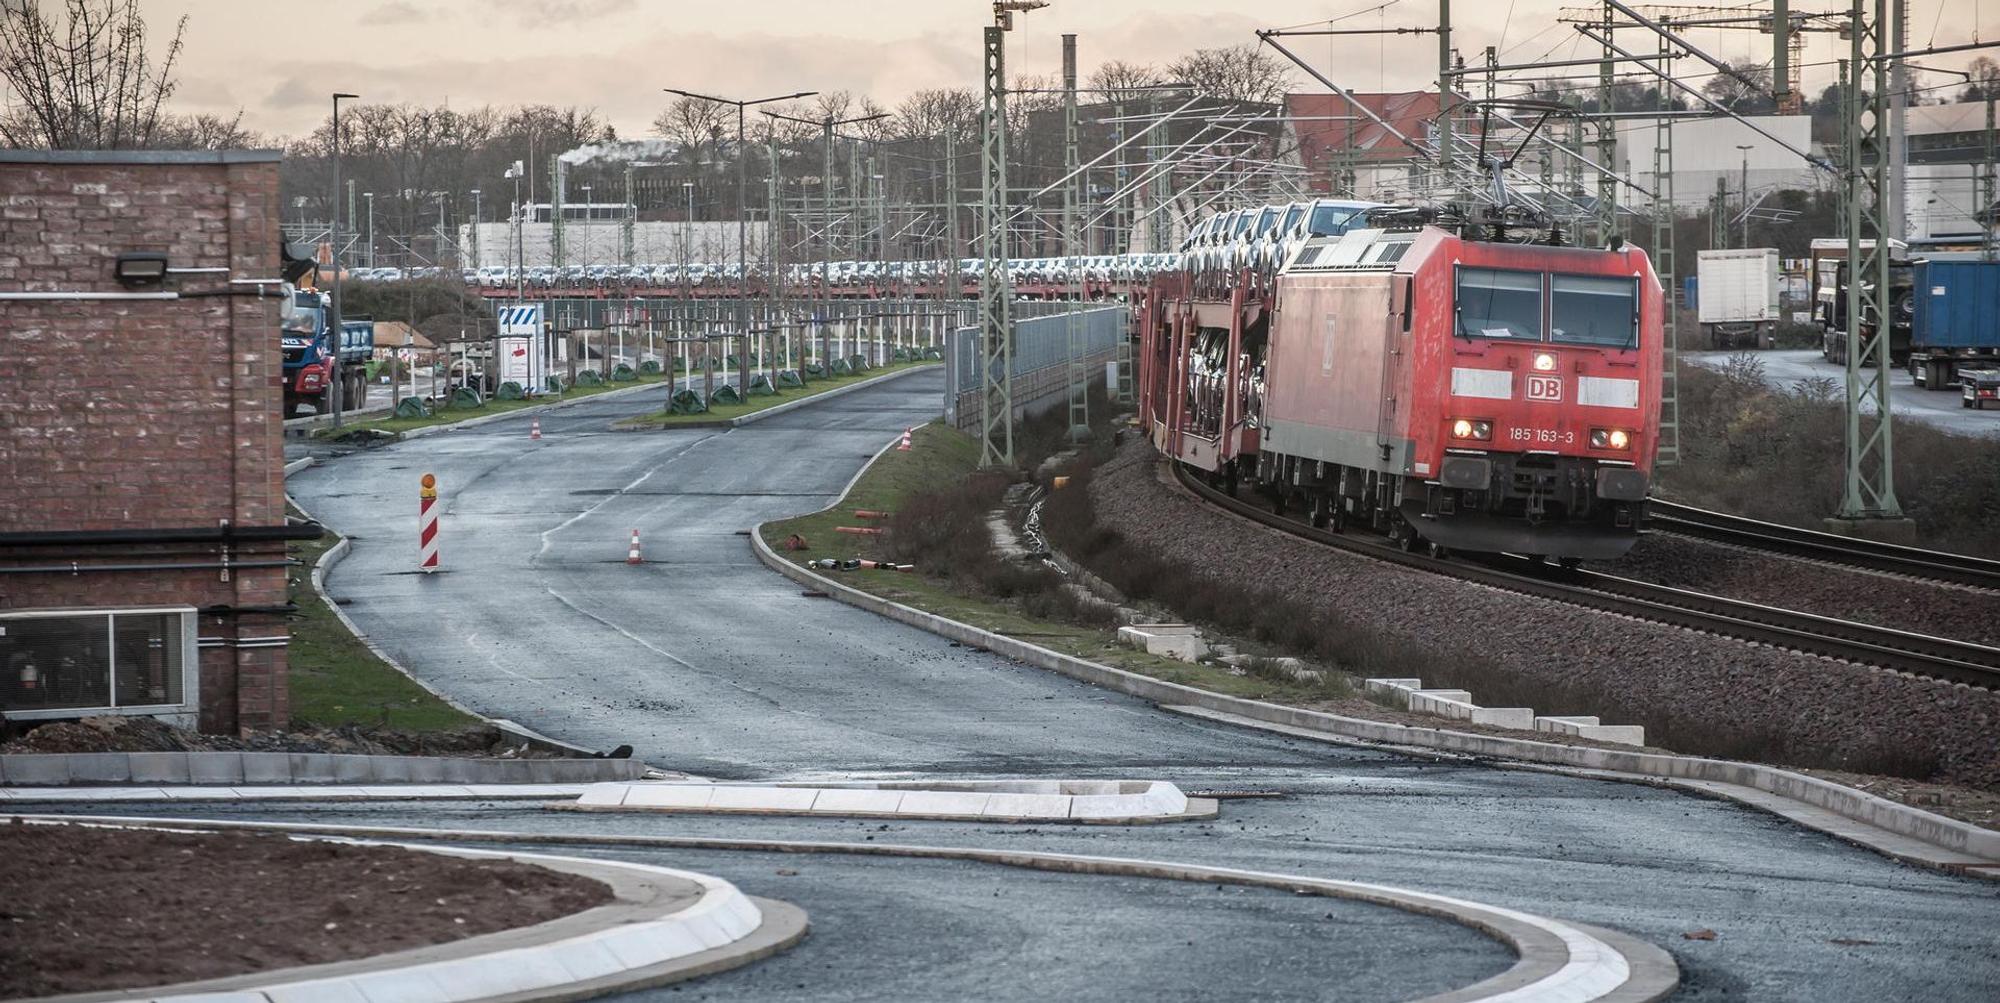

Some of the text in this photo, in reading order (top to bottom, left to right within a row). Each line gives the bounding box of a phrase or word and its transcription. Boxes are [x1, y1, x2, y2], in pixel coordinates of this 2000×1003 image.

[1530, 379, 1560, 398] DB
[1510, 427, 1574, 444] 185 163-3
